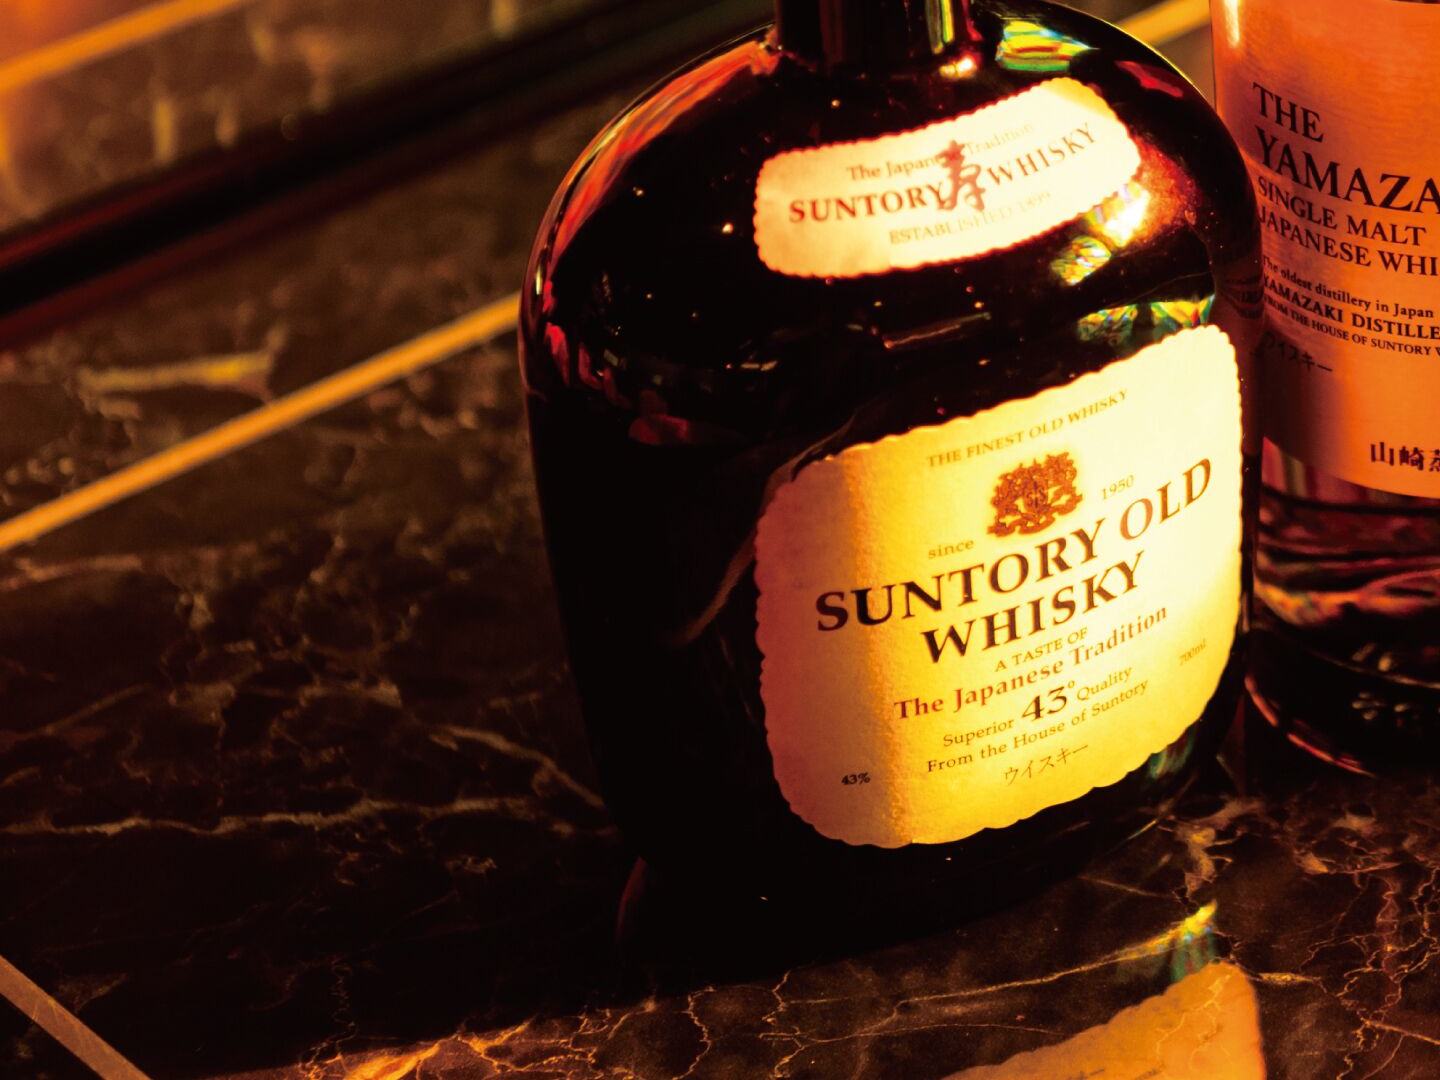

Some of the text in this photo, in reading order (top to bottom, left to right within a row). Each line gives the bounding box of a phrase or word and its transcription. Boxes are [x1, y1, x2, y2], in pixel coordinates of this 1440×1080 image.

[1252, 82, 1325, 143] THE
[788, 122, 1097, 224] SUNTORY WHISKY
[847, 162, 881, 181] The
[965, 123, 1035, 156] Tradition
[1257, 175, 1426, 247] SINGLE MALT
[1257, 206, 1371, 267] JAPANESE
[1263, 274, 1343, 323] YAMAZAKI
[1281, 268, 1313, 292] oldest
[1315, 279, 1372, 312] distillery
[1375, 299, 1390, 313] in
[1393, 303, 1435, 320] Japan
[1290, 307, 1311, 328] THE
[1311, 318, 1350, 342] HOUSE
[1351, 332, 1368, 346] OF
[1370, 336, 1432, 357] SUNTORY
[926, 387, 1129, 468] THE FINEST OLD WHISKY
[1101, 474, 1136, 501] 1950
[816, 458, 1212, 632] SUNTORY OLD
[927, 539, 975, 560] since
[920, 550, 1145, 664] WHISKY
[893, 605, 1169, 720] The Japanese Tradition
[994, 626, 1089, 673] A TASTE OF
[1178, 636, 1208, 667] 700ml
[926, 678, 1149, 773] From the House of Suntory
[943, 718, 1015, 748] Superior
[1076, 666, 1133, 702] Quality
[841, 771, 871, 786] 43%
[1003, 742, 1090, 787] ウイスキー
